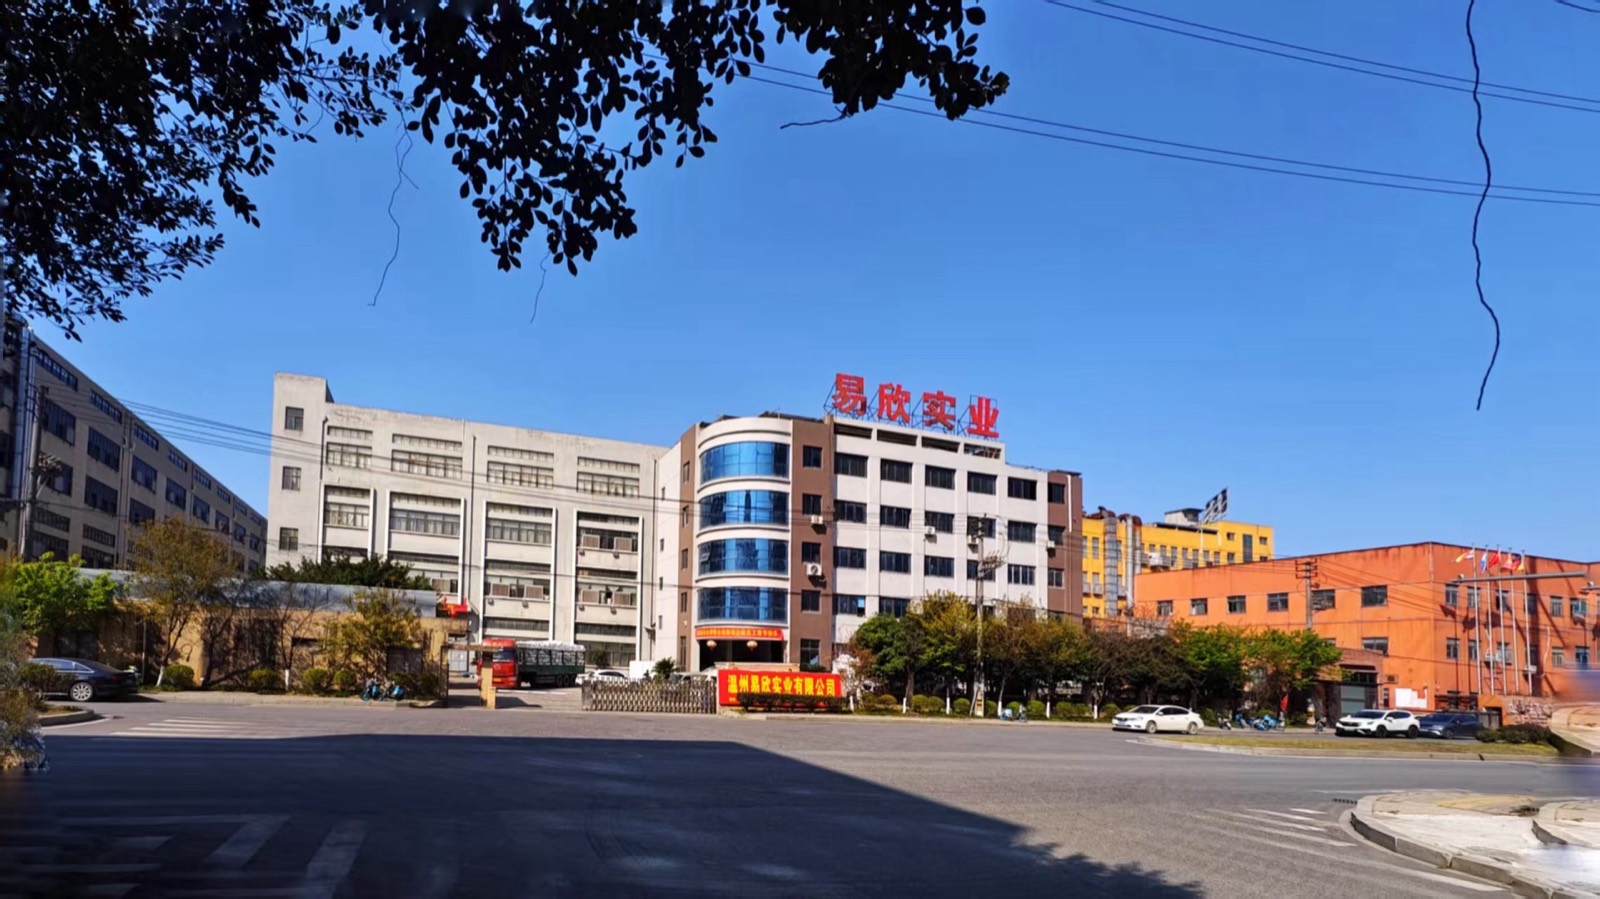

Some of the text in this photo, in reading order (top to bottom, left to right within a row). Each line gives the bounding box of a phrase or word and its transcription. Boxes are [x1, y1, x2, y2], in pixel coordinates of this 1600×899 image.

[832, 373, 999, 438] 易欣实业
[727, 674, 835, 697] 温州易欣实业有限公司
